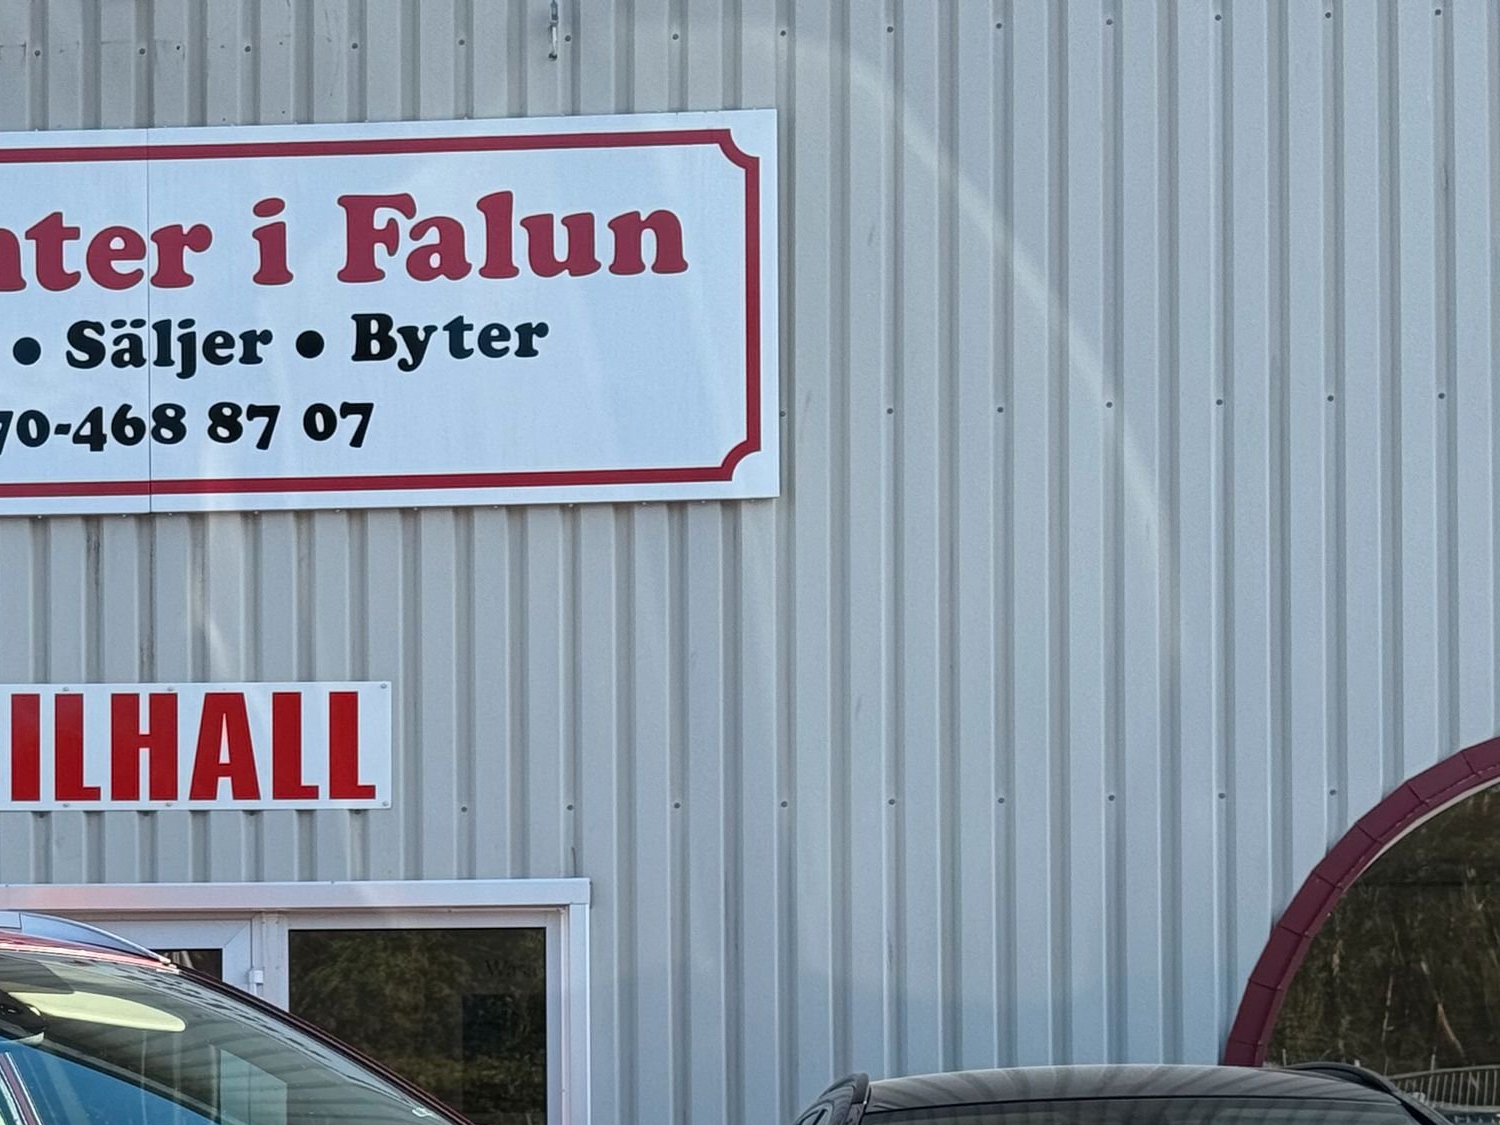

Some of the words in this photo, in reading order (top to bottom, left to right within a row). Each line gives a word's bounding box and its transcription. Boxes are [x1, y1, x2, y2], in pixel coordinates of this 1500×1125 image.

[252, 197, 294, 286] i
[336, 190, 689, 282] Falun
[65, 317, 273, 379] Säljer
[351, 312, 549, 372] Byter
[206, 402, 281, 450] 87
[302, 401, 374, 449] 07
